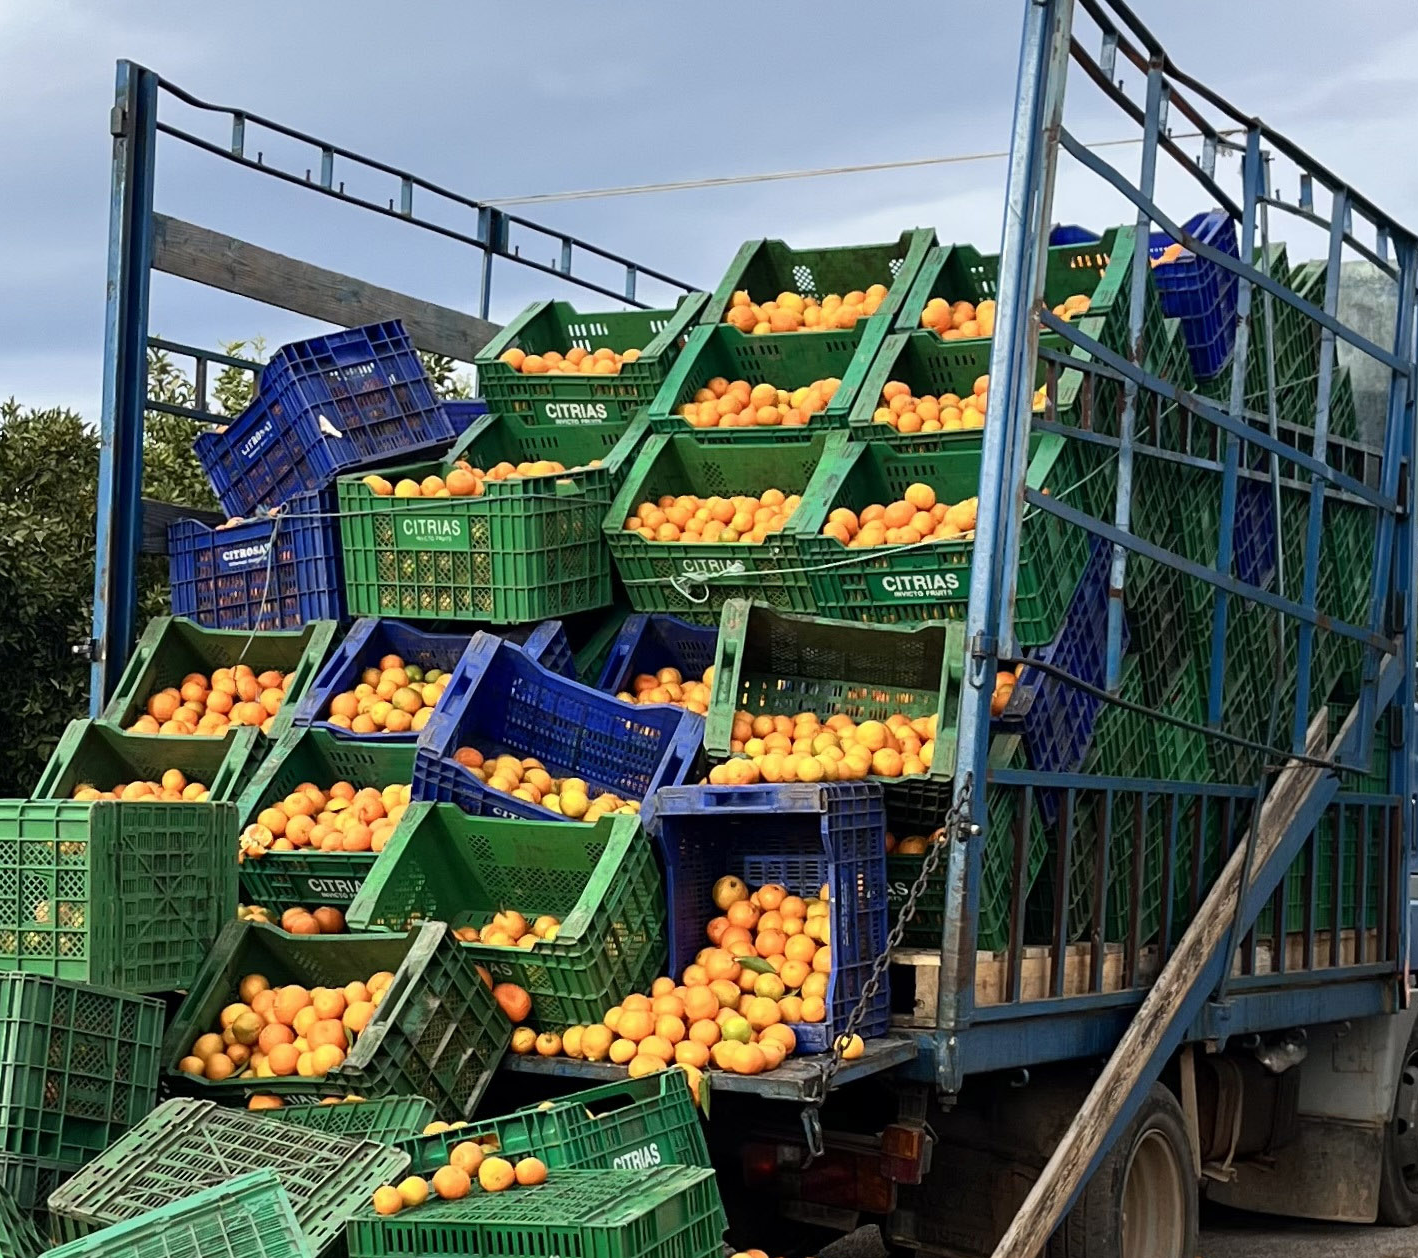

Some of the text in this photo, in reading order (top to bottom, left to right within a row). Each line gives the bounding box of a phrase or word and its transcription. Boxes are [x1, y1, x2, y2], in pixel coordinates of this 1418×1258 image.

[545, 403, 608, 419] CITRIAS
[403, 519, 461, 536] CITRIAS
[882, 573, 959, 591] CITRIAS
[308, 878, 363, 893] CITRIA
[613, 1143, 661, 1170] CITRIAS
